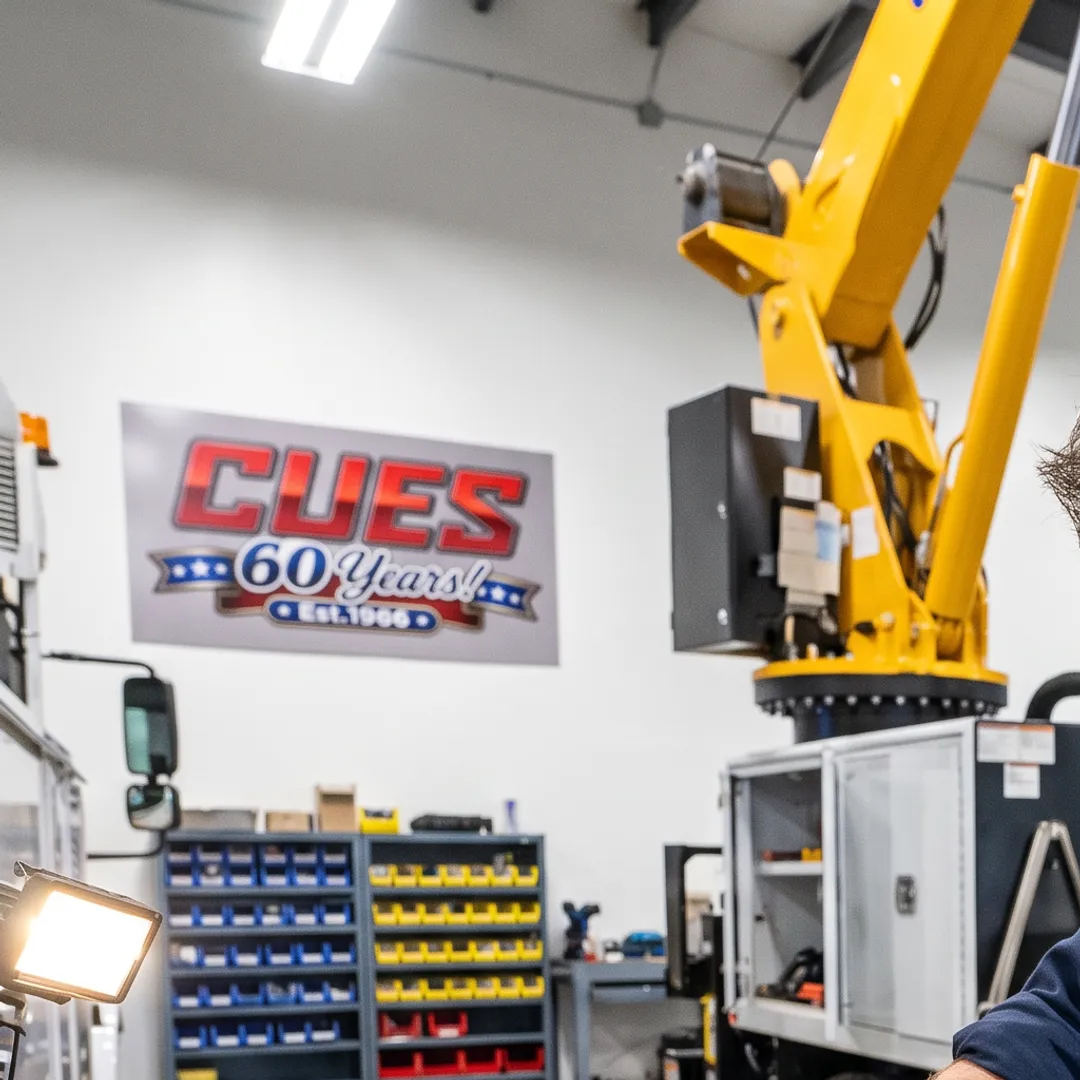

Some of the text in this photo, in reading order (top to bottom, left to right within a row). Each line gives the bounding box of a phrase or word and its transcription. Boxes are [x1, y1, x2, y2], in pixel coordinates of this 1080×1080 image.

[173, 438, 528, 557] CUES
[237, 540, 490, 603] 60 Years!
